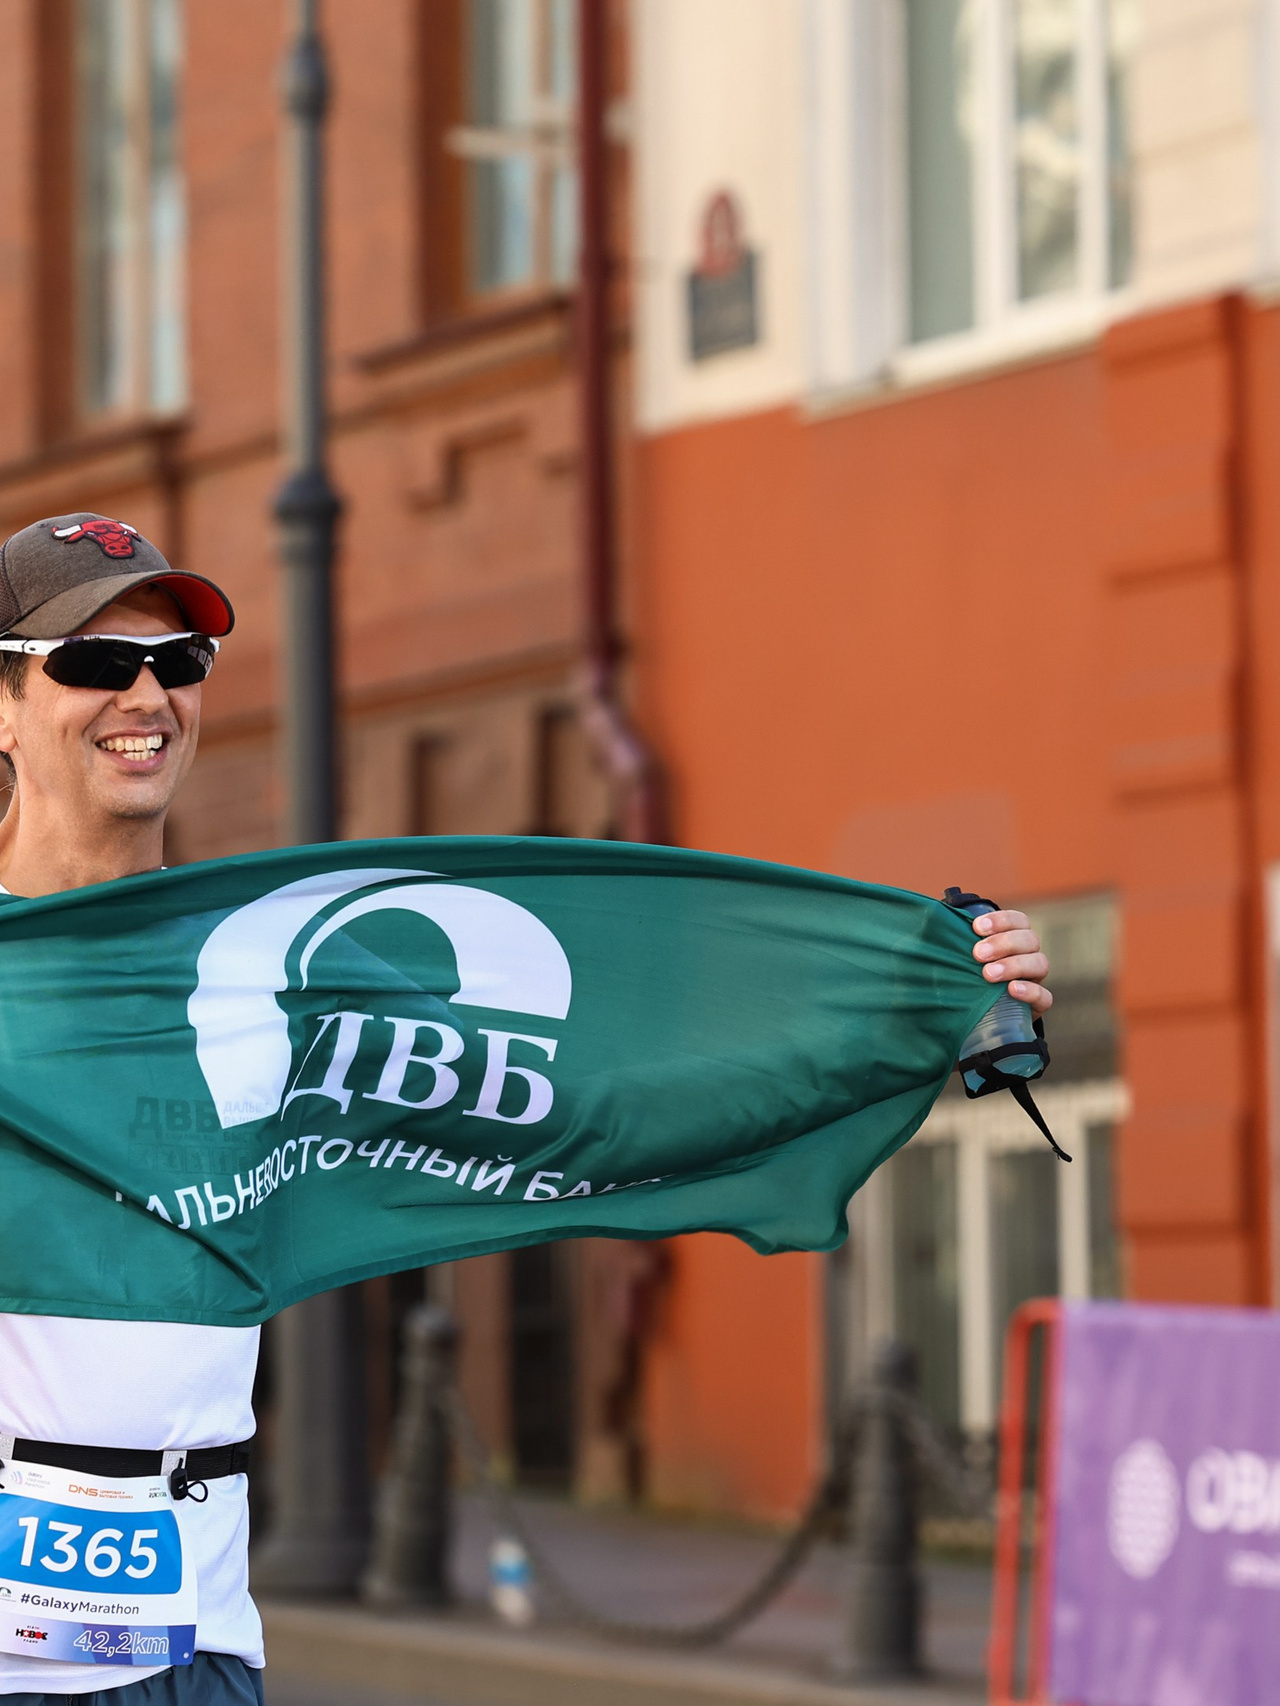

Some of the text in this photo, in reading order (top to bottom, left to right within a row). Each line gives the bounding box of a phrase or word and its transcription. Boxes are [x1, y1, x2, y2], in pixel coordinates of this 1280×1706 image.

[281, 1010, 559, 1126] ДВБ
[117, 1135, 675, 1230] АЛЬНЕВОСТОЧНЫЙ БА
[68, 1484, 98, 1497] DNS
[18, 1516, 158, 1579] 1365
[20, 1593, 140, 1615] #GalaxyMarathon
[73, 1630, 169, 1656] 42,2km
